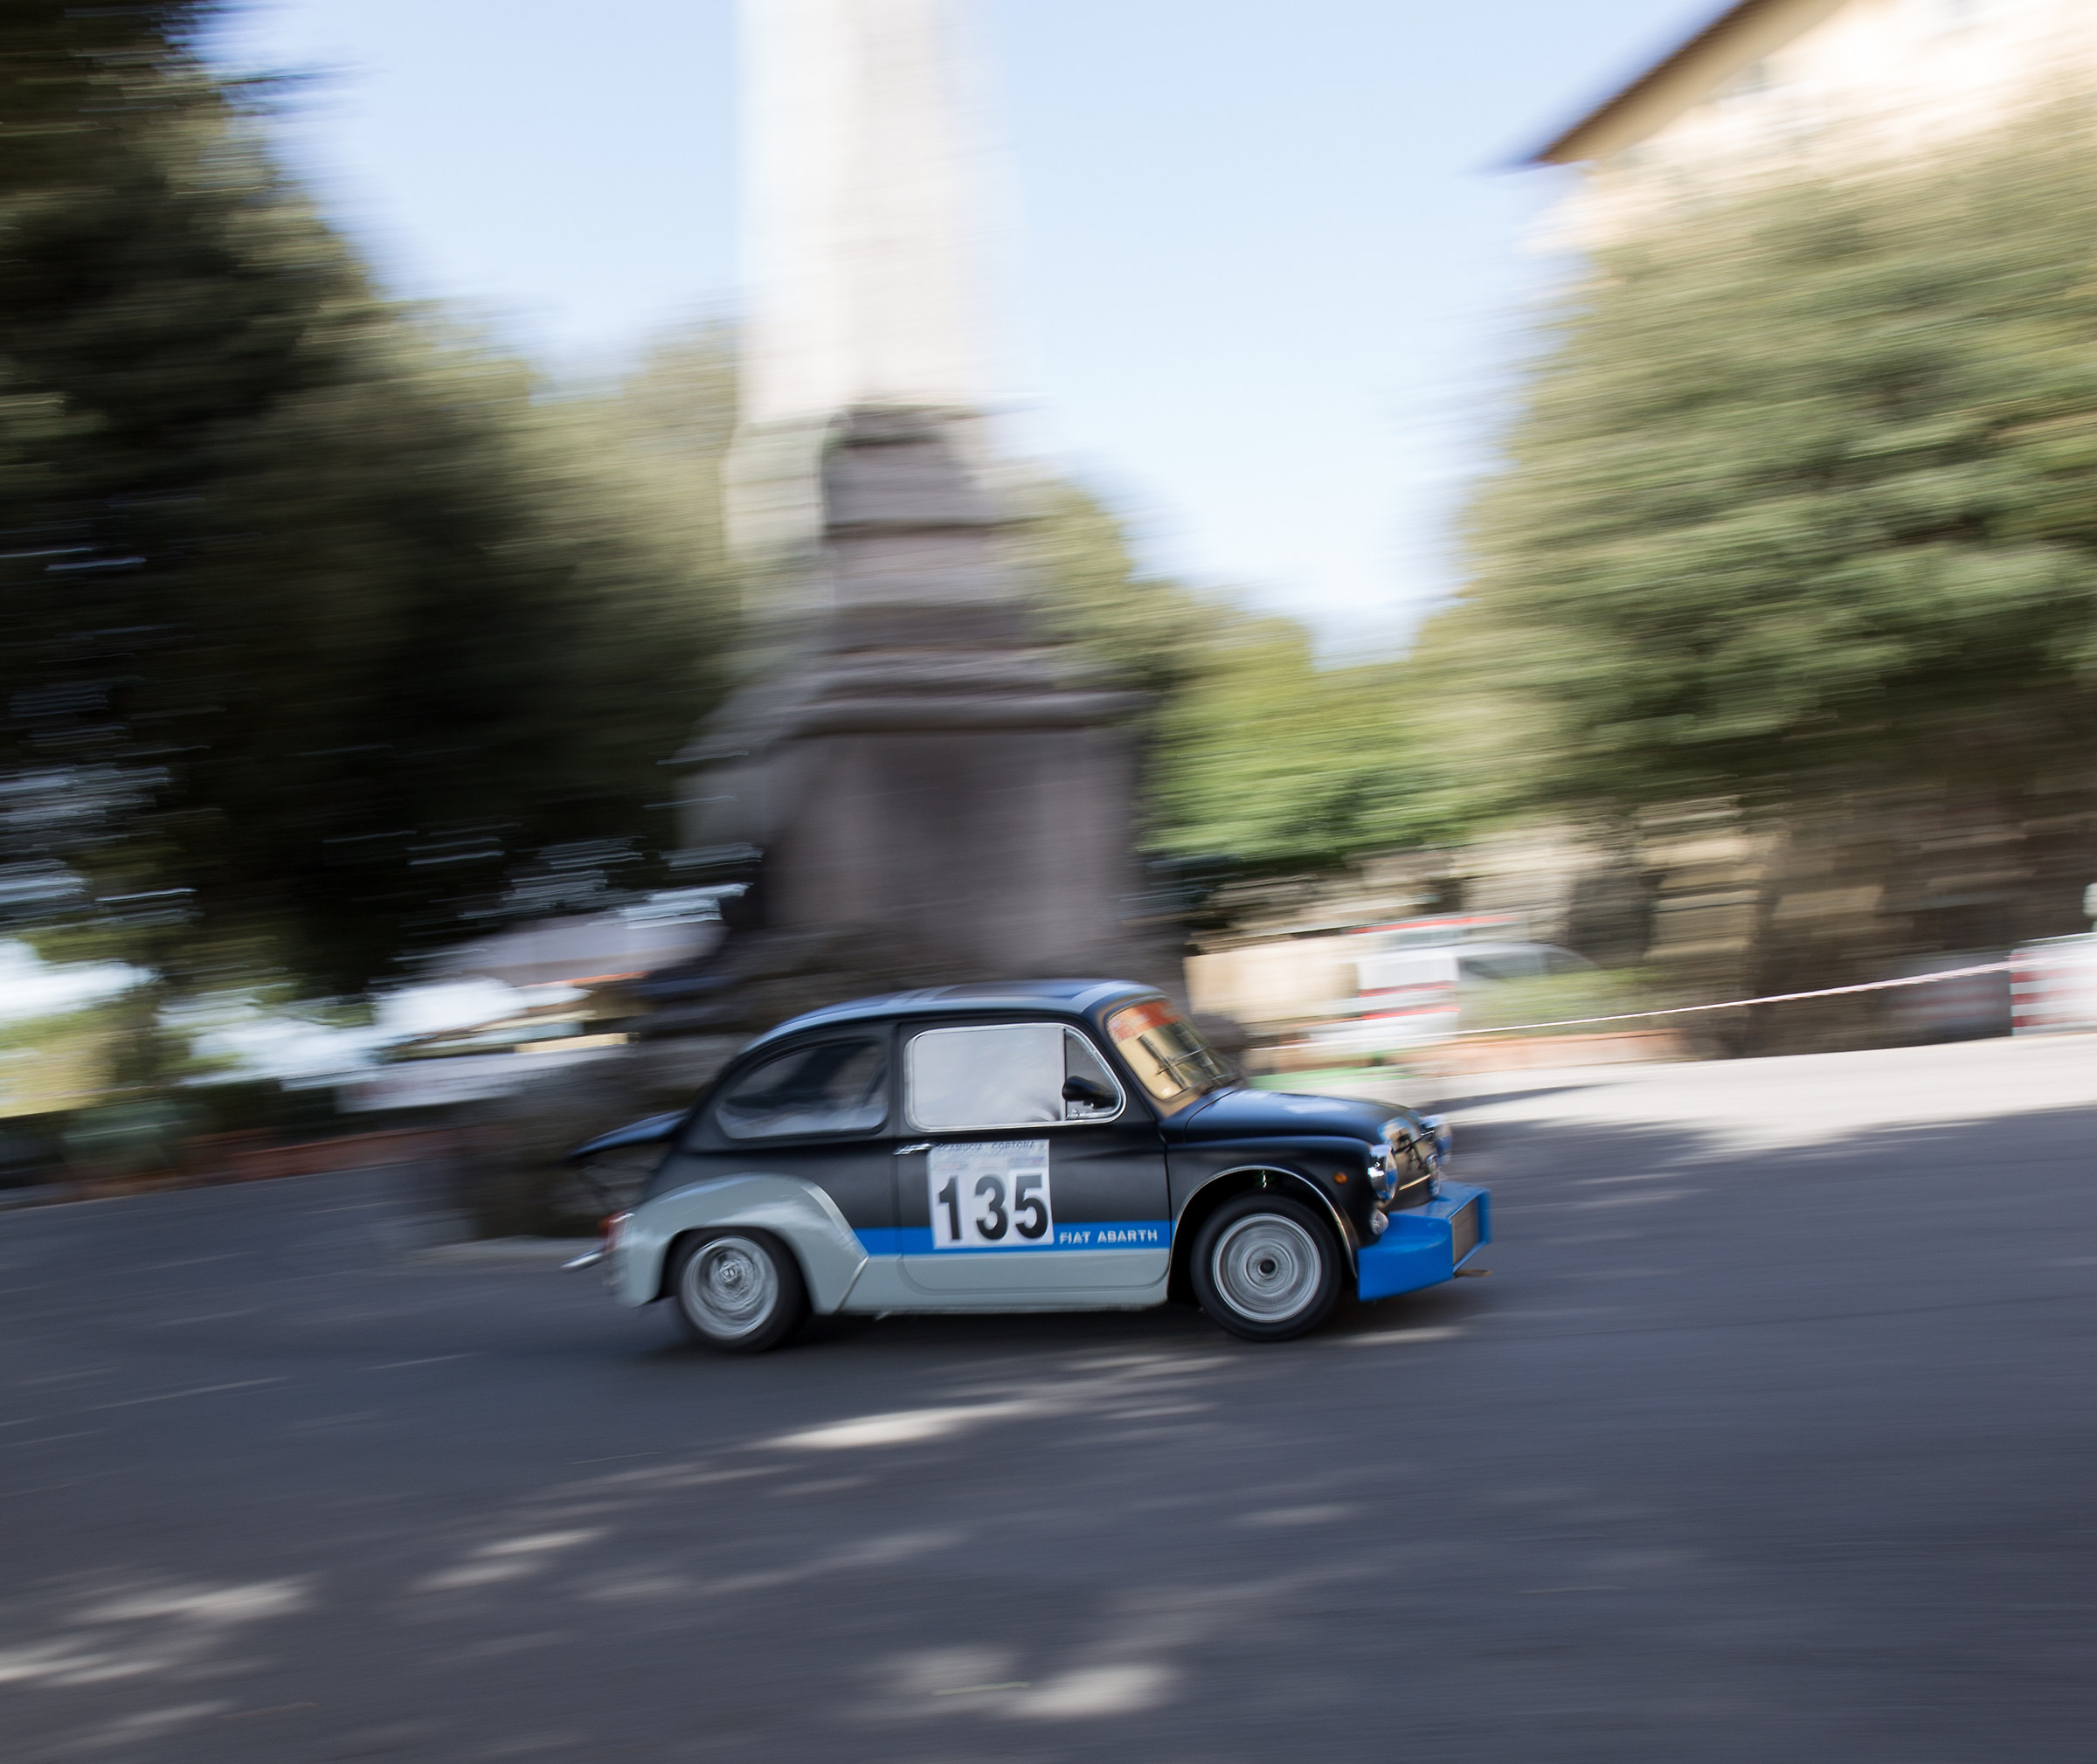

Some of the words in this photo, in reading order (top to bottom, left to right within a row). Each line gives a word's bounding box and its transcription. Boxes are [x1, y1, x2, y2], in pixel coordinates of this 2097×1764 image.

[938, 1173, 1048, 1242] 135
[1059, 1231, 1090, 1245] FIAT
[1097, 1229, 1158, 1243] ABARTH
